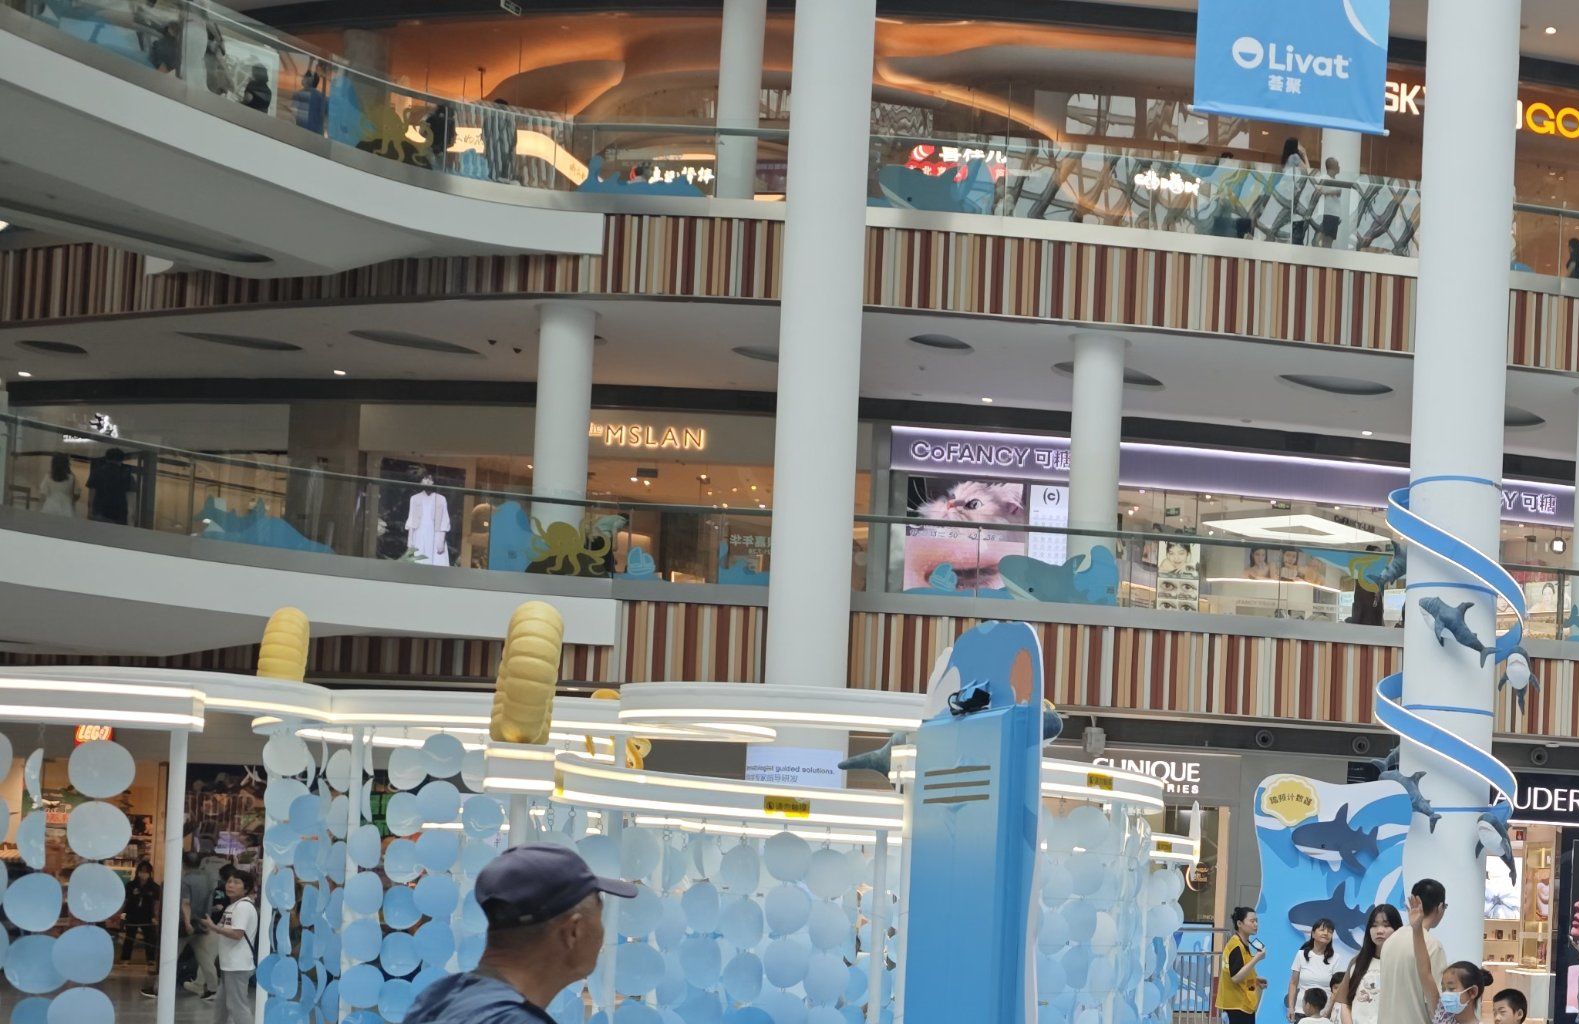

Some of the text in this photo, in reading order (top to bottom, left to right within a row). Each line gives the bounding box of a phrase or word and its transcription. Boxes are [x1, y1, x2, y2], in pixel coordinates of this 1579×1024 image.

[1268, 43, 1350, 79] Livat
[1268, 75, 1301, 94] 荟聚
[1384, 81, 1427, 116] SK
[604, 424, 707, 450] MSLAN
[911, 440, 1030, 467] CoFANCY
